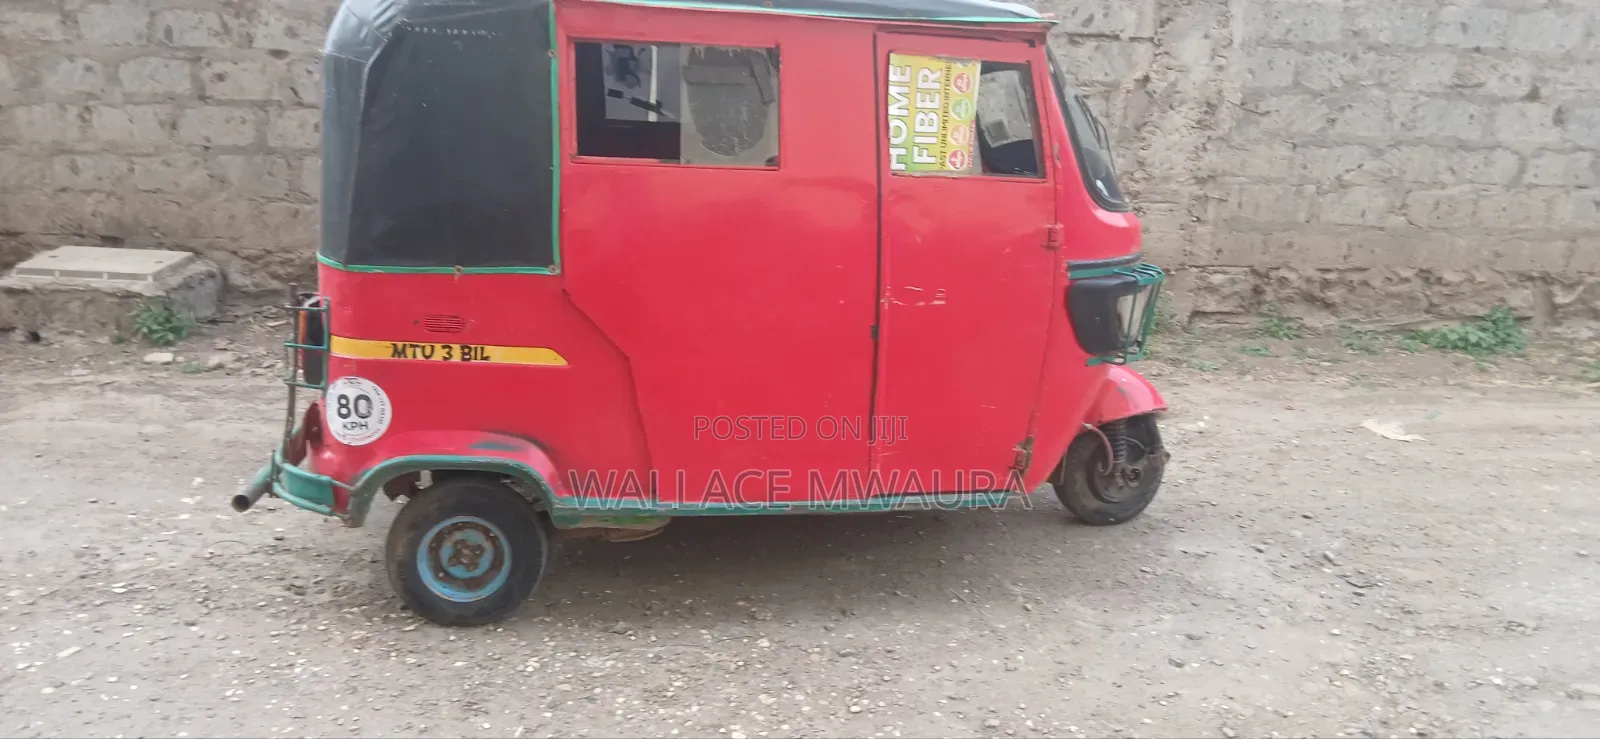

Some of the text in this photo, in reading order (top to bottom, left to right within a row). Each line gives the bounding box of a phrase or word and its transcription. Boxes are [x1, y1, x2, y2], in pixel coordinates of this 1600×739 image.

[889, 64, 911, 171] HOME
[912, 67, 942, 164] FIBER
[939, 64, 952, 169] AST UNLIMITED INTERNE
[390, 343, 490, 361] MTU 3 BIL
[336, 393, 374, 419] 80
[342, 421, 369, 431] KPH
